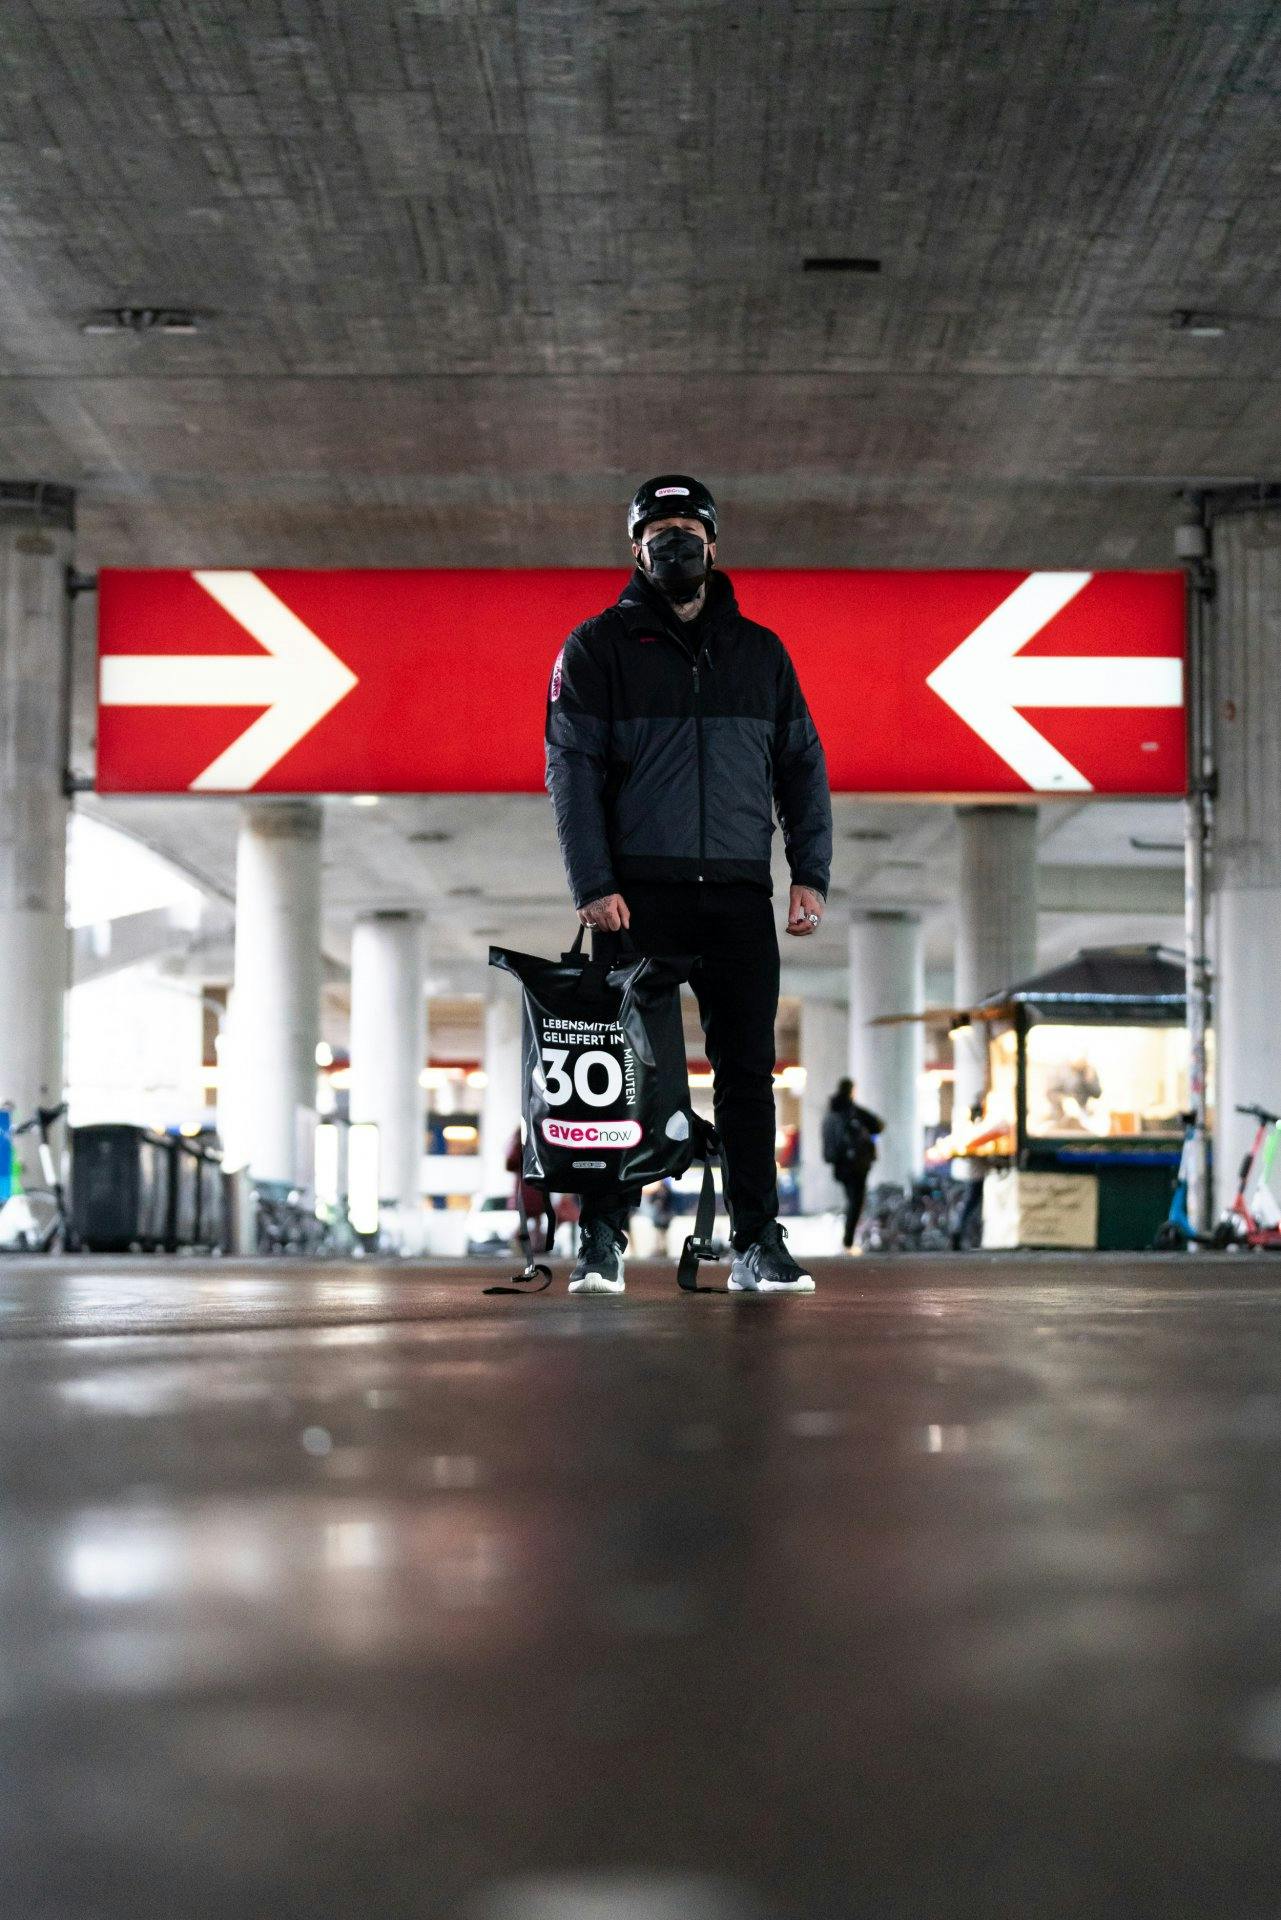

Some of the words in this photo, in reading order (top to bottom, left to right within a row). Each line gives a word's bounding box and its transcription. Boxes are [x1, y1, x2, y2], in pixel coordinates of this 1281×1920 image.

[543, 1018, 623, 1031] LEBENSMITTEL
[543, 1031, 605, 1045] GELIEFERT
[610, 1033, 625, 1045] IN
[542, 1047, 623, 1107] 30
[623, 1047, 636, 1105] MINUTEN
[548, 1124, 632, 1141] avecnow
